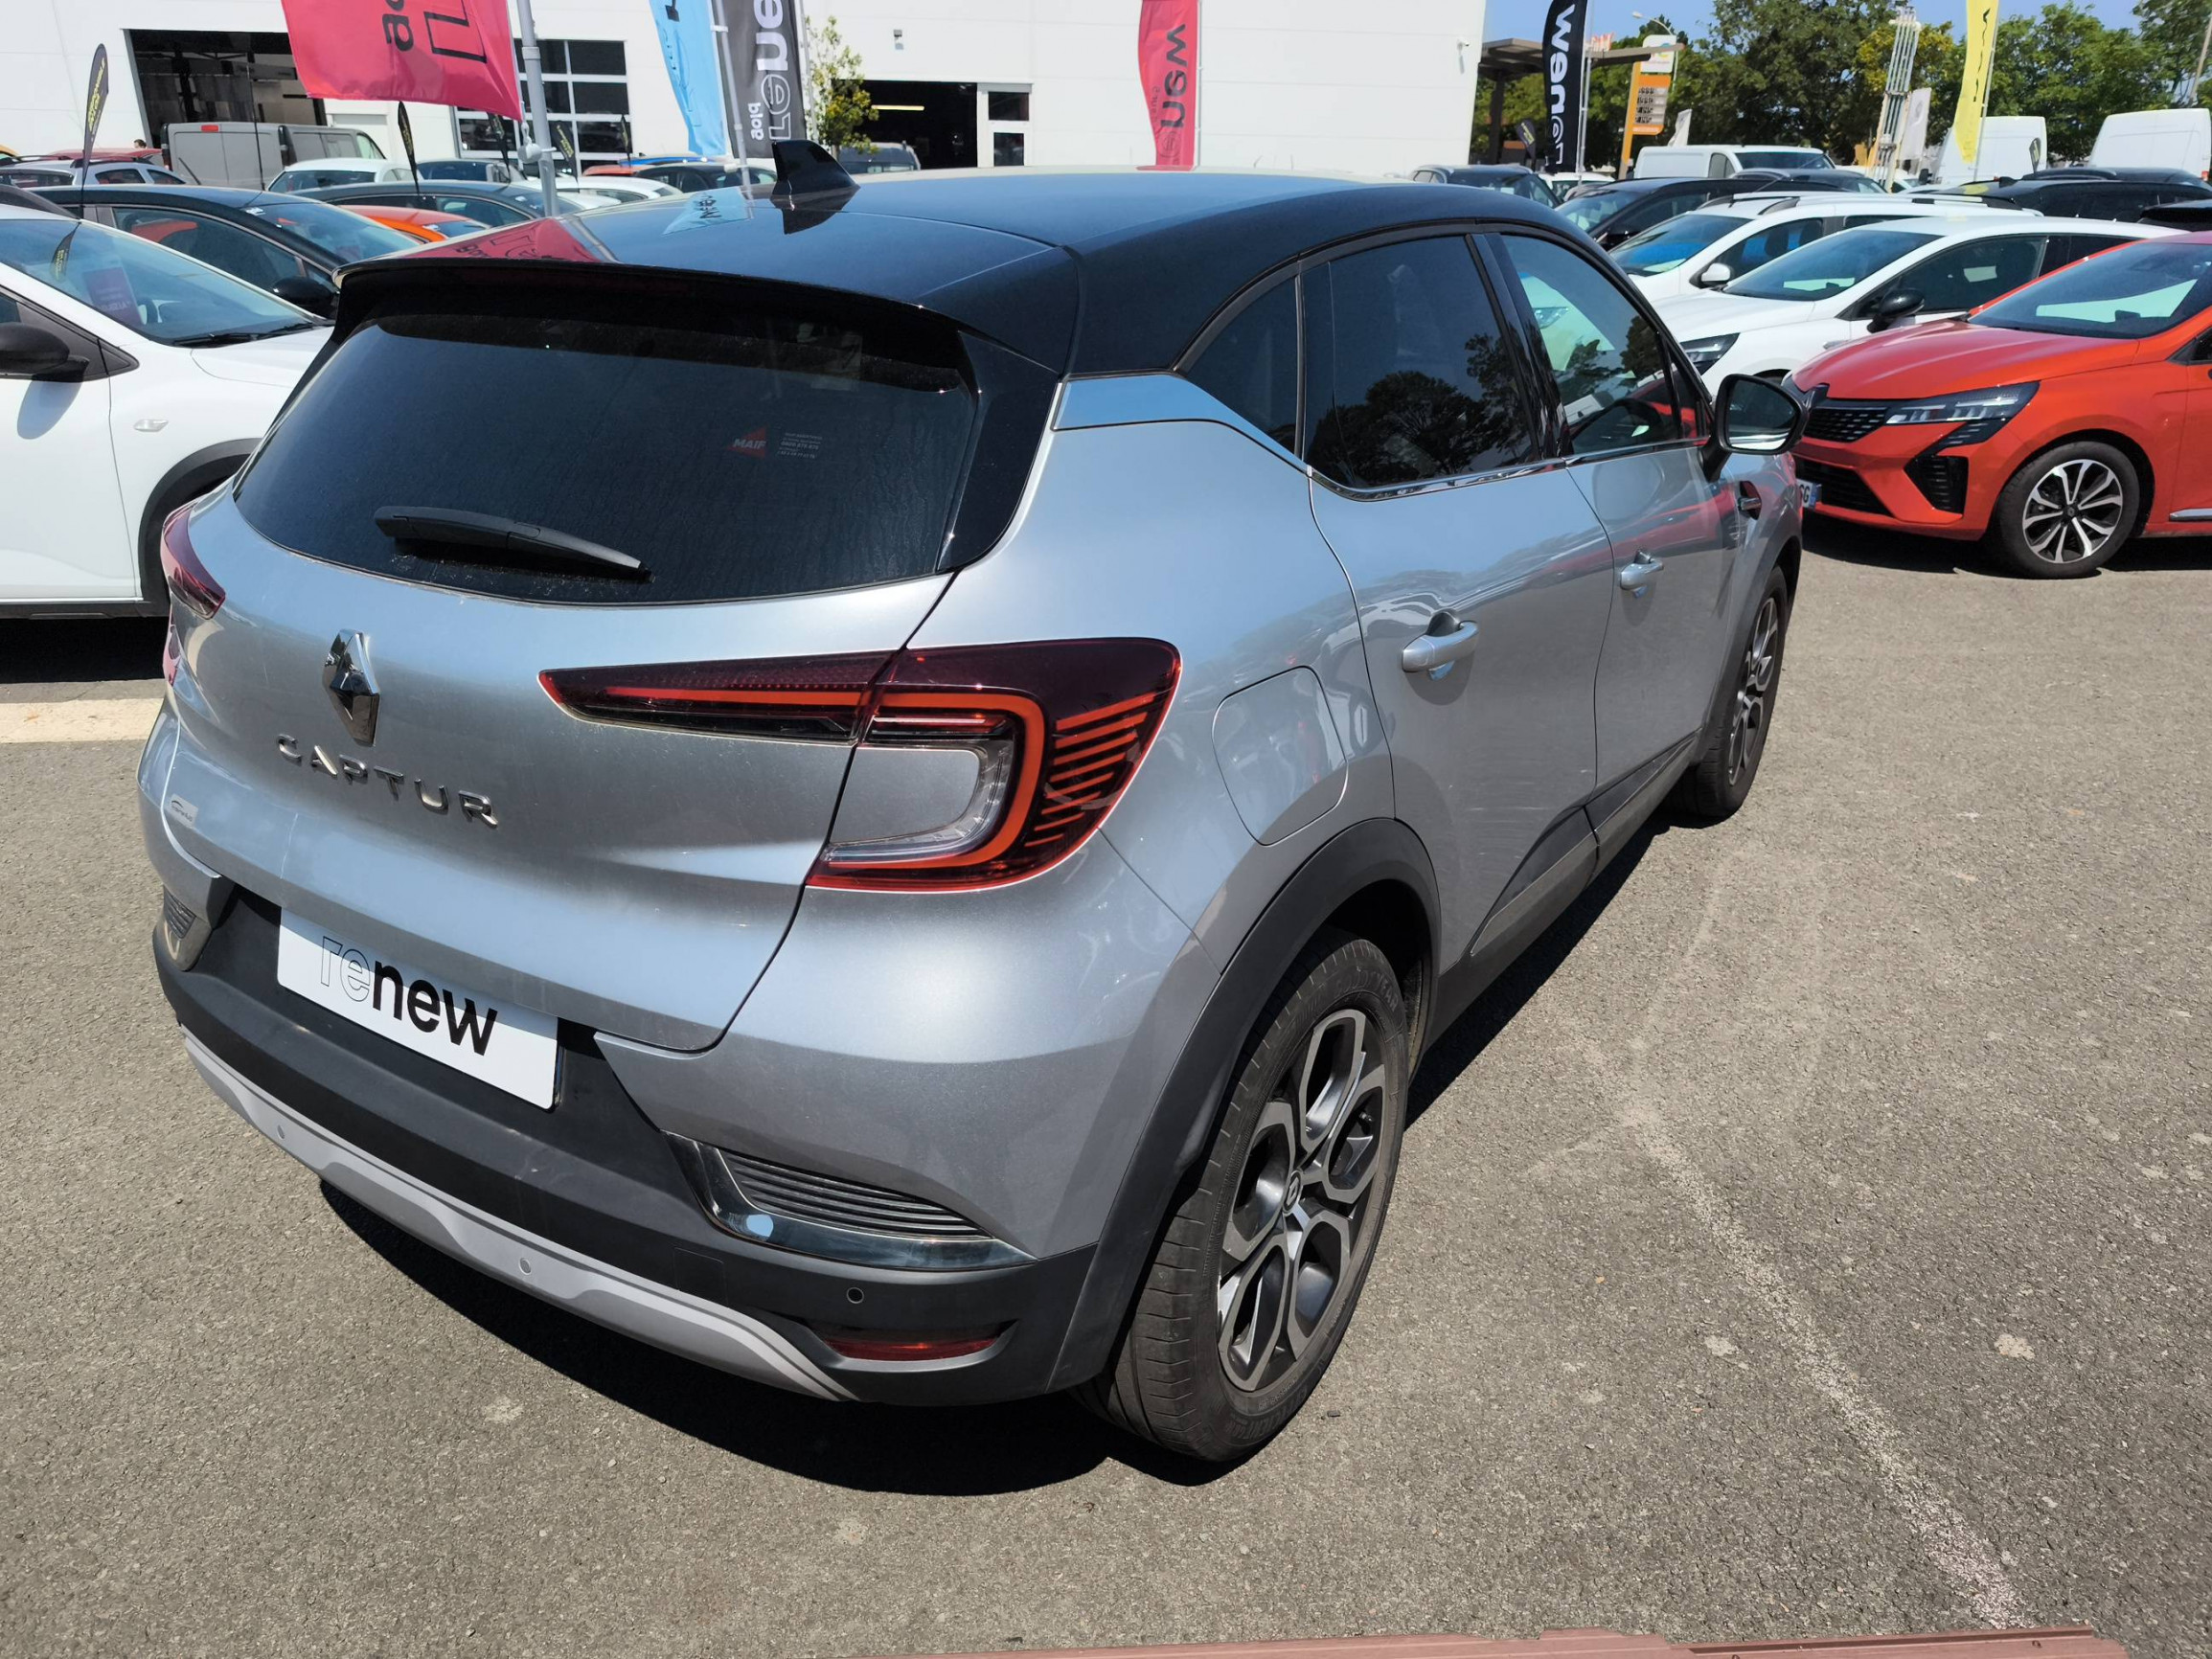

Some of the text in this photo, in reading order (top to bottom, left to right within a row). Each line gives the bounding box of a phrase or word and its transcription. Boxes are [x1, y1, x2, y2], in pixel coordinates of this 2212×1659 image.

[732, 438, 766, 450] MAIF
[276, 733, 499, 830] CAPTUR
[320, 936, 498, 1057] renew
